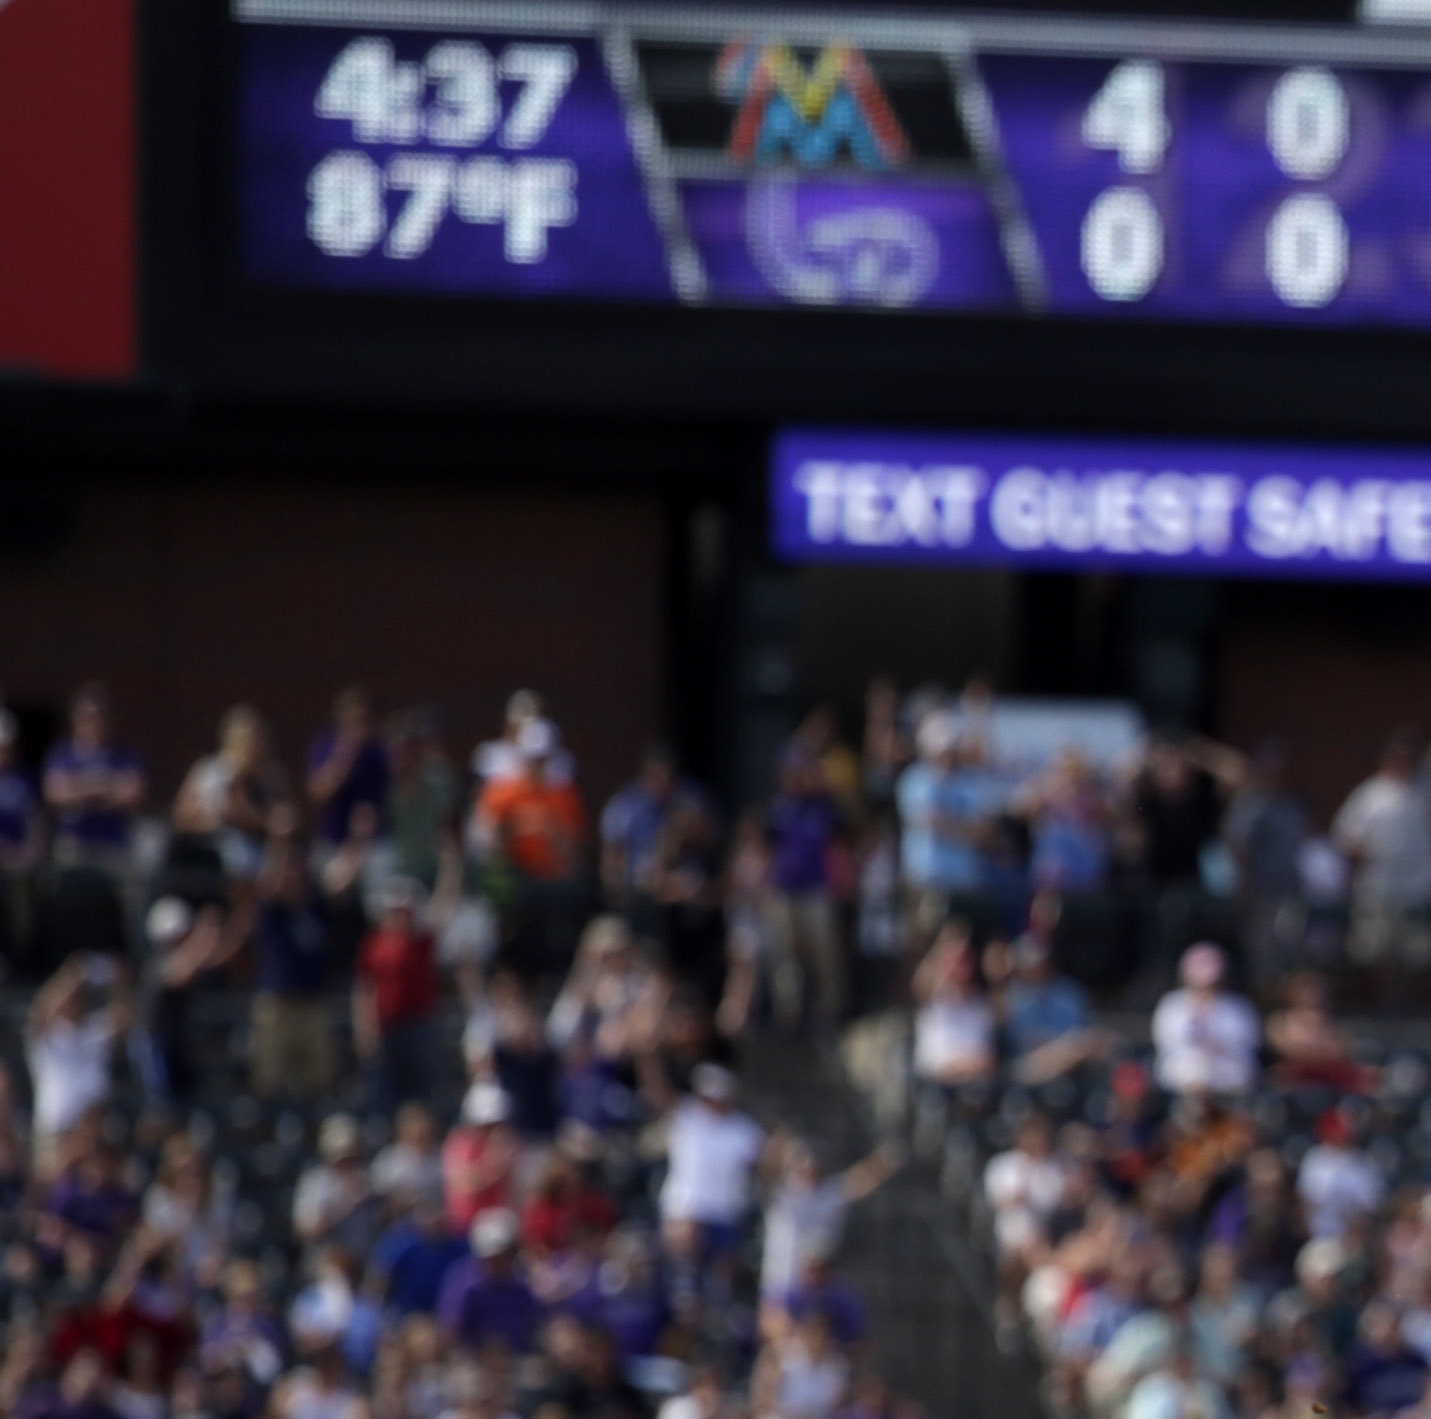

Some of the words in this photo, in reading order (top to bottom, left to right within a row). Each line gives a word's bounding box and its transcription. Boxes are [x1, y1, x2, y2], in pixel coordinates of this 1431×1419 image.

[316, 38, 579, 150] 4:37
[1081, 61, 1171, 174] 4
[1266, 68, 1348, 179] 0
[1081, 187, 1164, 302] 0
[1264, 193, 1349, 308] 0
[795, 461, 984, 548] TEXT
[990, 466, 1242, 556] GUEST
